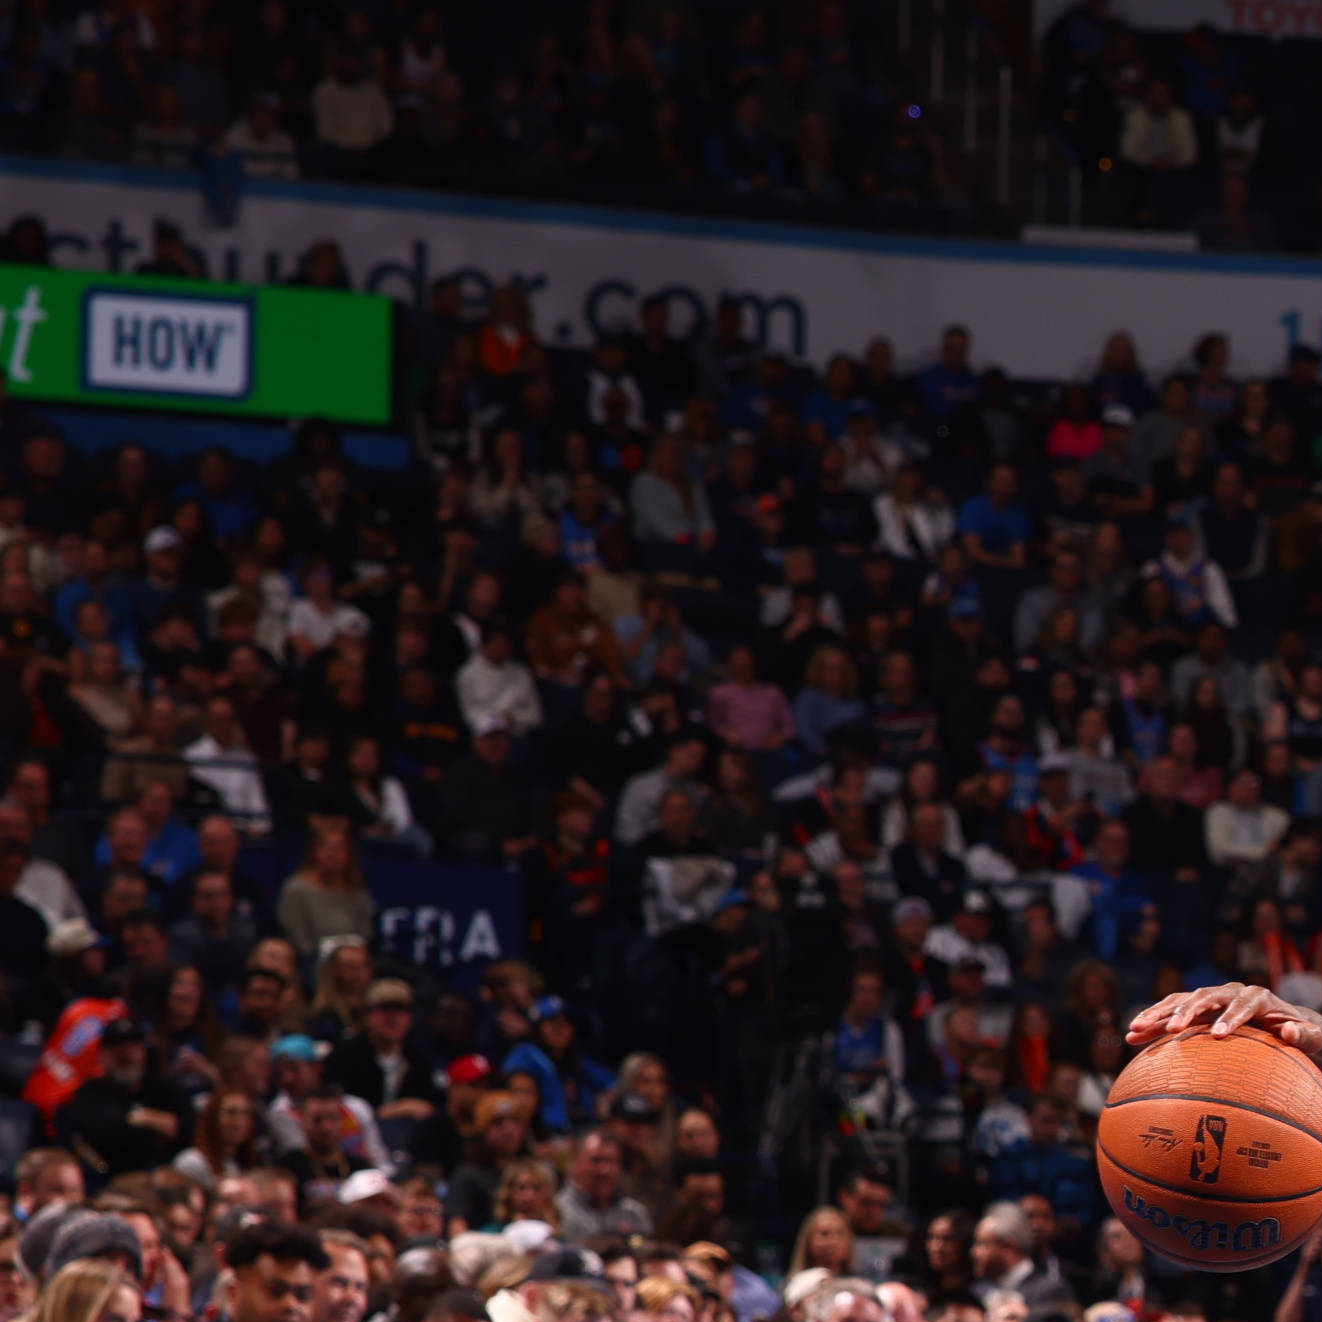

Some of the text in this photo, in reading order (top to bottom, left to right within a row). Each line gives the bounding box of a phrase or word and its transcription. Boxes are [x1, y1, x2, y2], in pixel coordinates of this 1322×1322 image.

[0, 283, 224, 383] t HOW
[1121, 1183, 1282, 1252] Wilson
